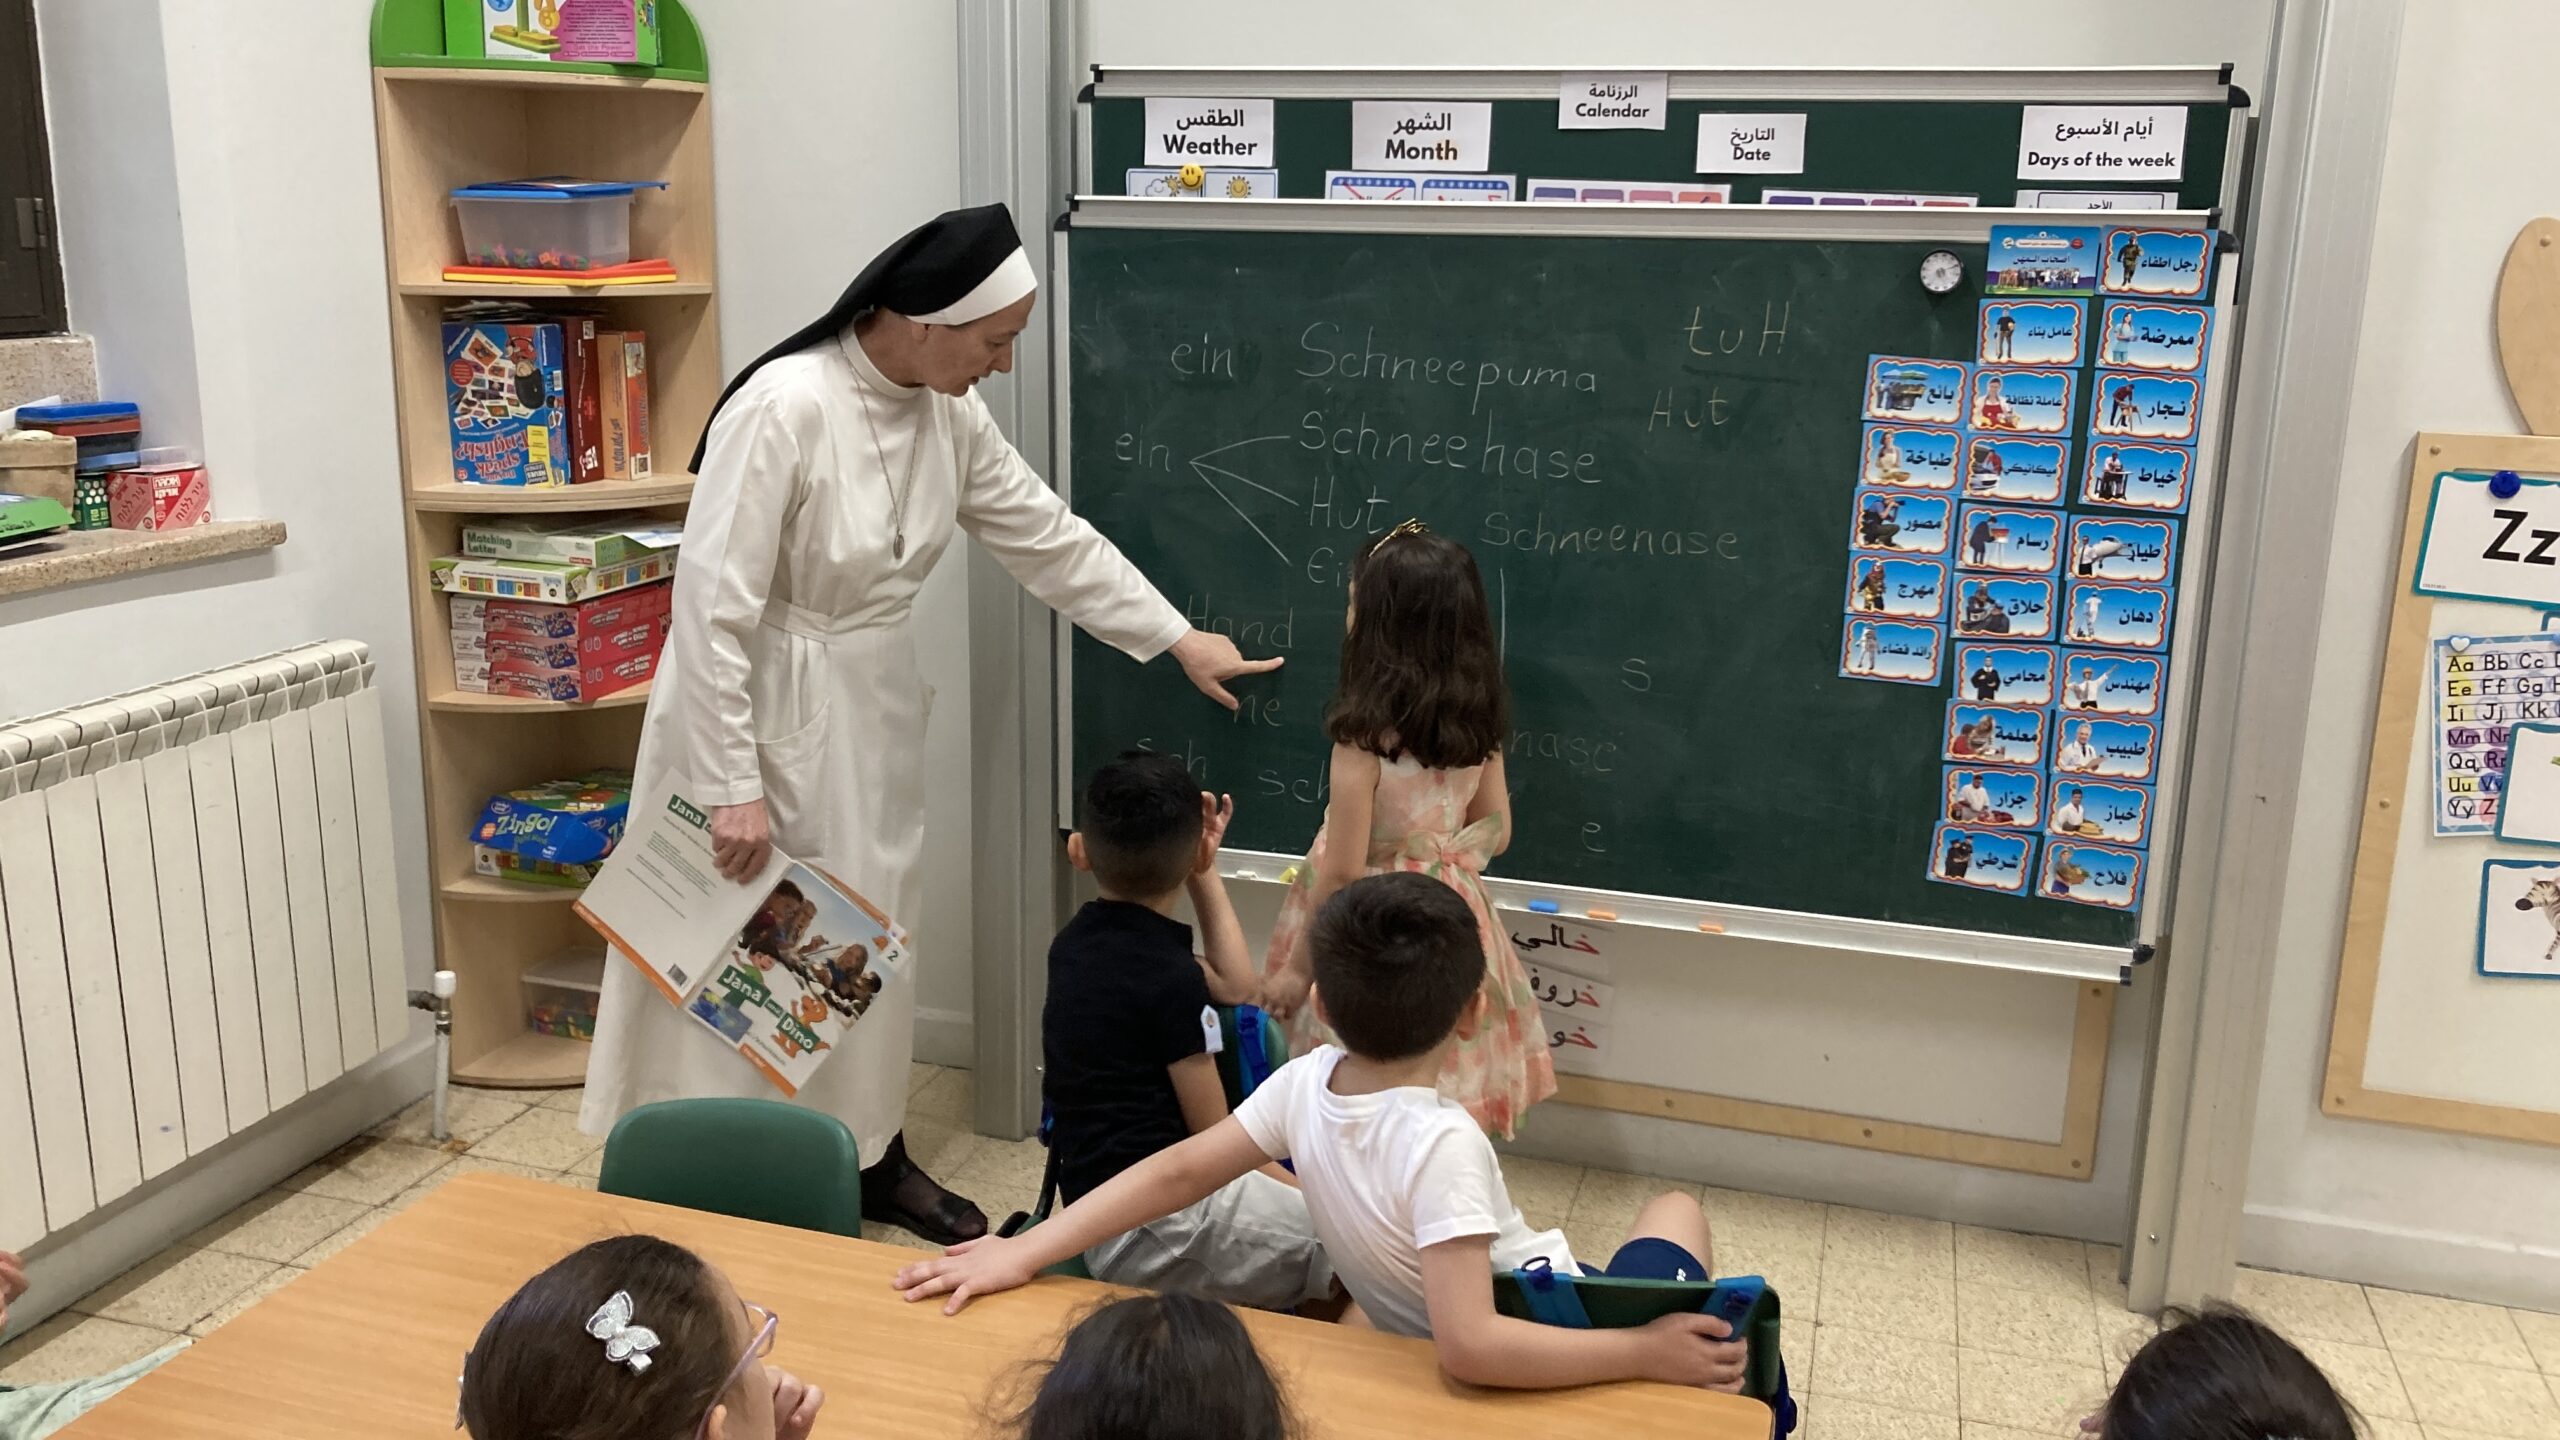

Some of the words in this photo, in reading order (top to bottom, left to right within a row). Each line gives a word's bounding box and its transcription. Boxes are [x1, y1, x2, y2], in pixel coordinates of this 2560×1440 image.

[1588, 83, 1639, 103] الرزنامة
[1175, 109, 1245, 133] الطقس
[1575, 103, 1650, 119] Calendar
[1392, 113, 1452, 136] الشهر
[2055, 120, 2119, 140] الأسبوع
[2122, 118, 2154, 138] أيام
[1163, 133, 1258, 157] Weather
[1730, 127, 1776, 149] التاريخ
[1385, 139, 1459, 161] Month
[1733, 148, 1772, 162] Date
[2028, 152, 2071, 171] Days
[2074, 152, 2093, 167] of
[2095, 152, 2123, 168] the
[2126, 153, 2176, 169] week
[2173, 256, 2198, 272] رجل
[1683, 300, 1790, 356] tuH
[2028, 325, 2046, 339] بناء
[2048, 324, 2073, 339] عامل
[2141, 326, 2195, 348] ممرضة
[1171, 332, 1233, 378] ein
[1296, 321, 1597, 416] Schneepuma
[1648, 386, 1730, 432] Hut
[2035, 395, 2063, 407] عاملة
[2147, 400, 2187, 420] نجار
[454, 429, 529, 462] English?
[1115, 423, 1171, 472] ein
[1299, 408, 1601, 484] Schneehase
[475, 452, 521, 478] speak
[1906, 450, 1952, 470] طباخة
[2003, 463, 2058, 477] ميكانيكي
[2138, 467, 2177, 488] خياط
[1309, 475, 1391, 535] Hut
[466, 532, 513, 550] Matching
[1480, 511, 1741, 560] Schneenase
[2016, 533, 2049, 550] رسام
[2482, 508, 2560, 566] Zz
[467, 543, 497, 555] Letter
[1897, 583, 1935, 599] مهرج
[2007, 598, 2045, 616] حلاق
[2119, 608, 2154, 625] دهان
[2448, 655, 2474, 672] Aa
[2484, 654, 2509, 671] Bb
[2519, 653, 2545, 669] Cc
[2003, 669, 2046, 687] محامي
[2105, 678, 2151, 695] مهندس
[2448, 680, 2472, 697] Ee
[2482, 679, 2507, 696] Ff
[2517, 678, 2543, 697] Gg
[2447, 704, 2464, 722] Ii
[2482, 703, 2504, 723] Jj
[2521, 702, 2548, 719] Kk
[1994, 725, 2038, 743] معلمة
[2448, 729, 2481, 745] Mm
[2106, 742, 2146, 760] طبيب
[2449, 752, 2480, 773] Qq
[2449, 777, 2472, 792] Uu
[1995, 791, 2027, 808] جزار
[2449, 800, 2473, 819] Yy
[671, 798, 702, 825] Jana
[2104, 805, 2137, 824] خباز
[496, 813, 558, 836] Zingo!
[1581, 821, 1606, 853] e
[1975, 852, 2019, 870] شرطي
[2094, 869, 2127, 886] فلاح
[1511, 923, 1601, 956] خالي
[887, 950, 899, 962] 2
[722, 969, 763, 1002] Jana
[781, 1017, 814, 1050] Dino
